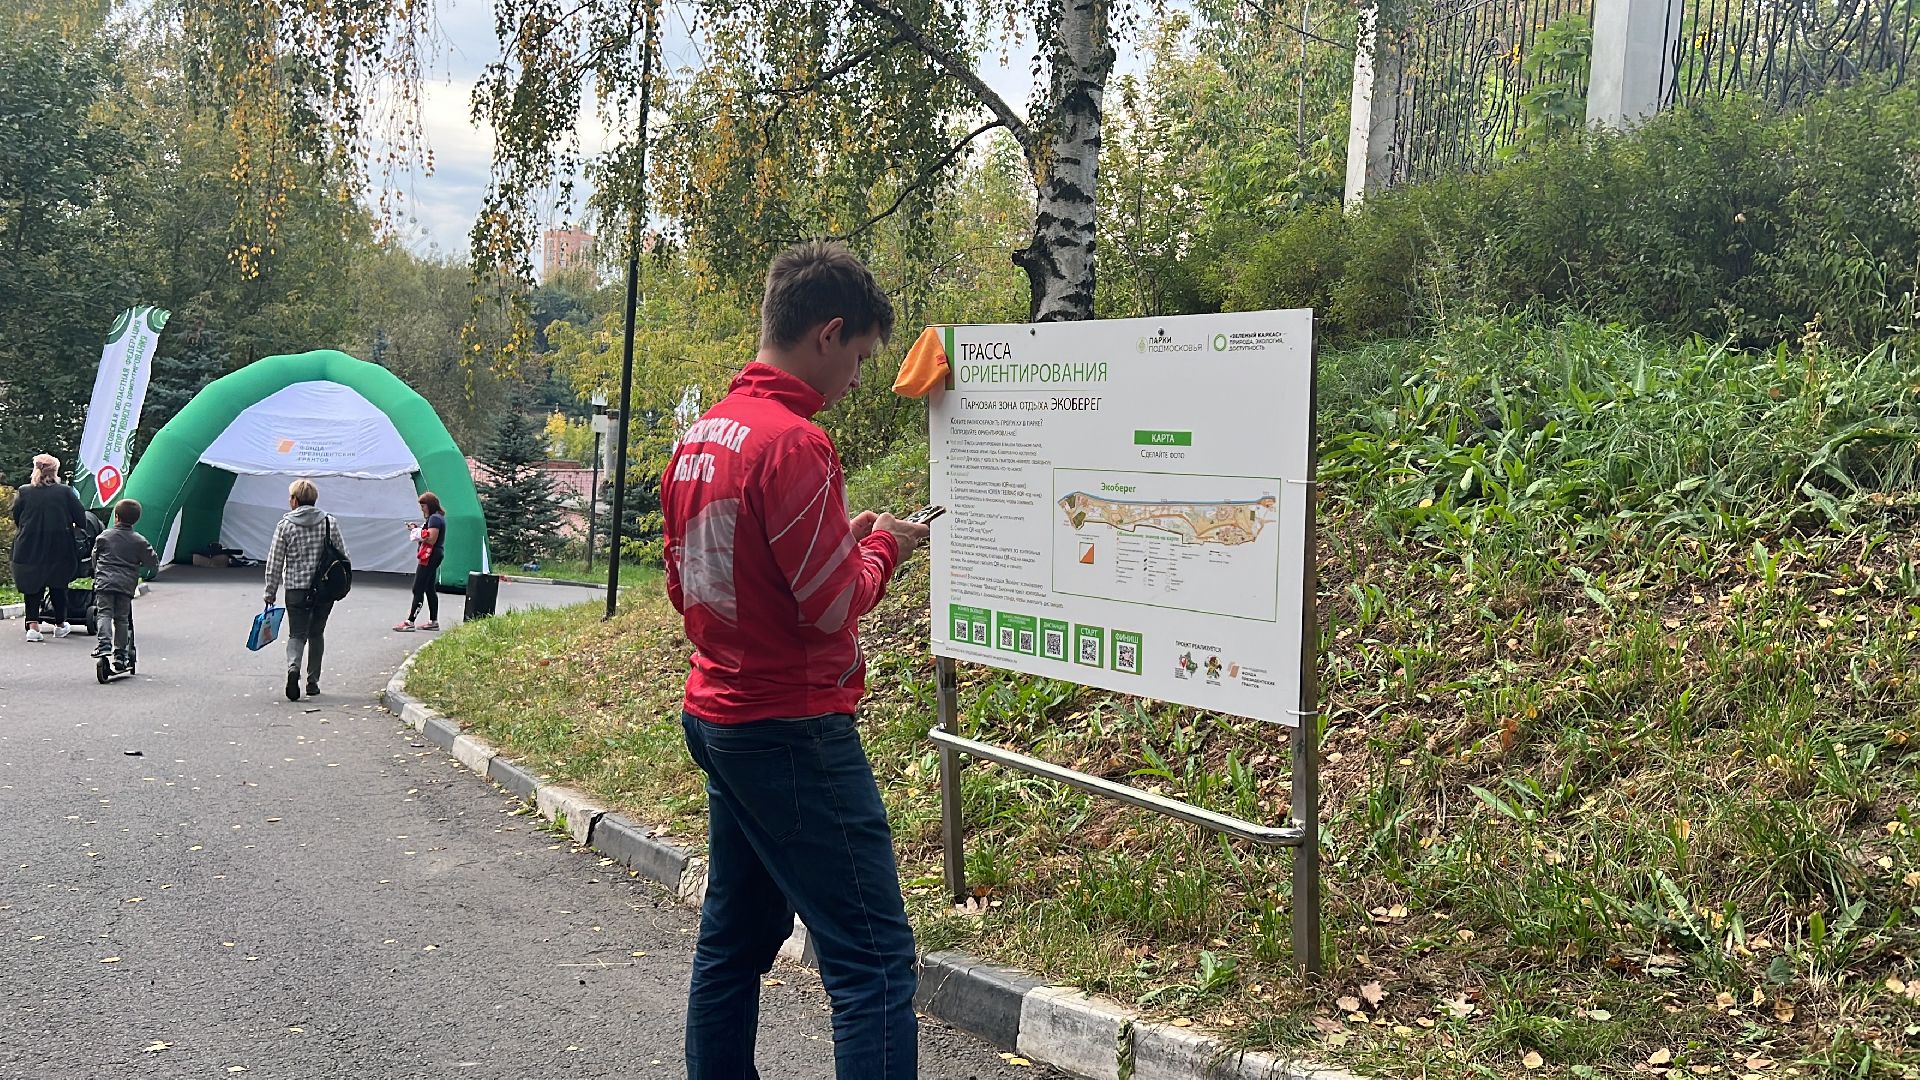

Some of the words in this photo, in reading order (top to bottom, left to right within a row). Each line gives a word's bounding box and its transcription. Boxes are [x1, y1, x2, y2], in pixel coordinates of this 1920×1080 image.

[960, 342, 1012, 361] ТРАССА
[1148, 344, 1203, 353] ПОДМОСКОВЬЯ
[960, 362, 1108, 383] ОРИЕНТИРОВАНИЯ
[103, 413, 119, 462] МОСКОВСКАЯ
[115, 367, 130, 411] ОБЛАСТНАЯ
[126, 320, 141, 365] ФЕДЕРАЦИЯ
[1050, 397, 1102, 411] ЭКОБЕРЕГ
[114, 402, 132, 453] СПОРТИВНОГО
[1151, 433, 1175, 443] КАРТА
[1100, 483, 1137, 494] Экоберег
[1080, 627, 1098, 637] СТАРТ
[1115, 632, 1139, 644] ФИНИШ
